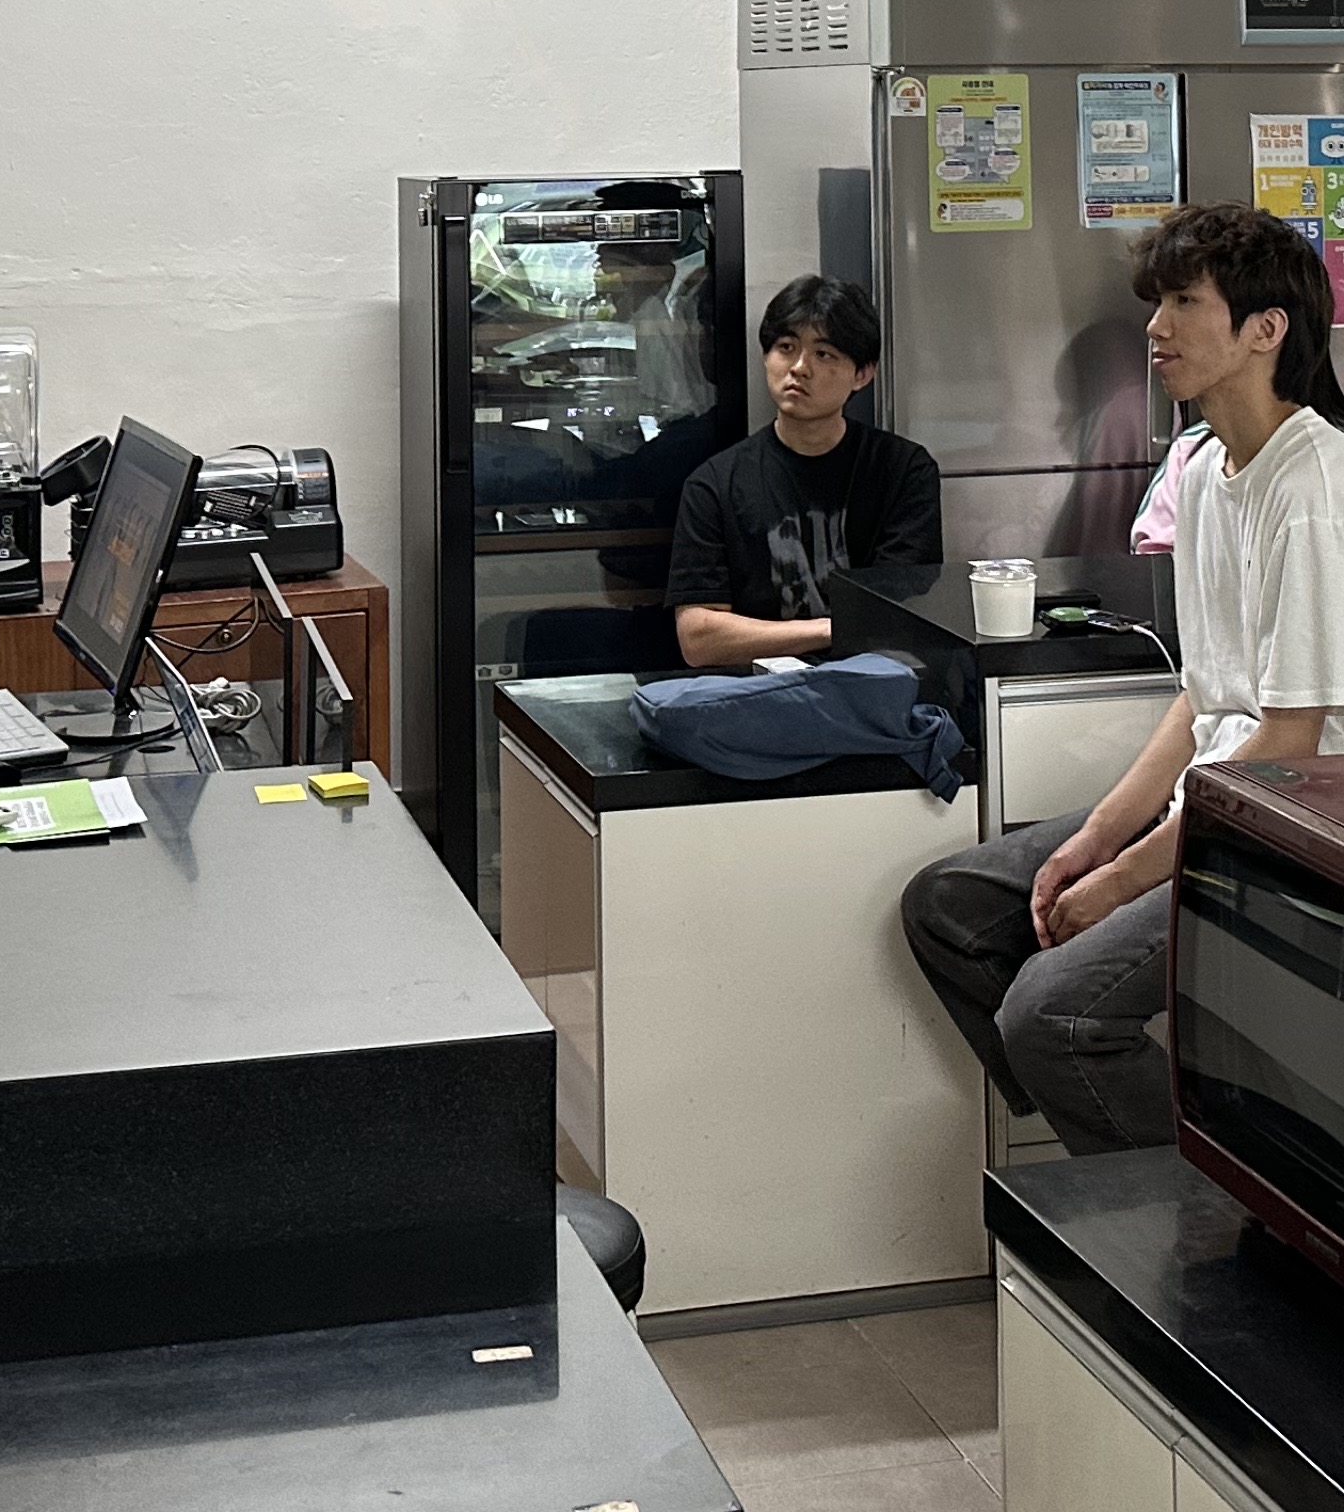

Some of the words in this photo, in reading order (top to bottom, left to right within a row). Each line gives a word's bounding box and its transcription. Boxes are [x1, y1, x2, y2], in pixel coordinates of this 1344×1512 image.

[1257, 124, 1304, 138] 개인방역
[1259, 173, 1270, 191] 1
[1326, 171, 1338, 190] 3
[1306, 221, 1319, 239] 5
